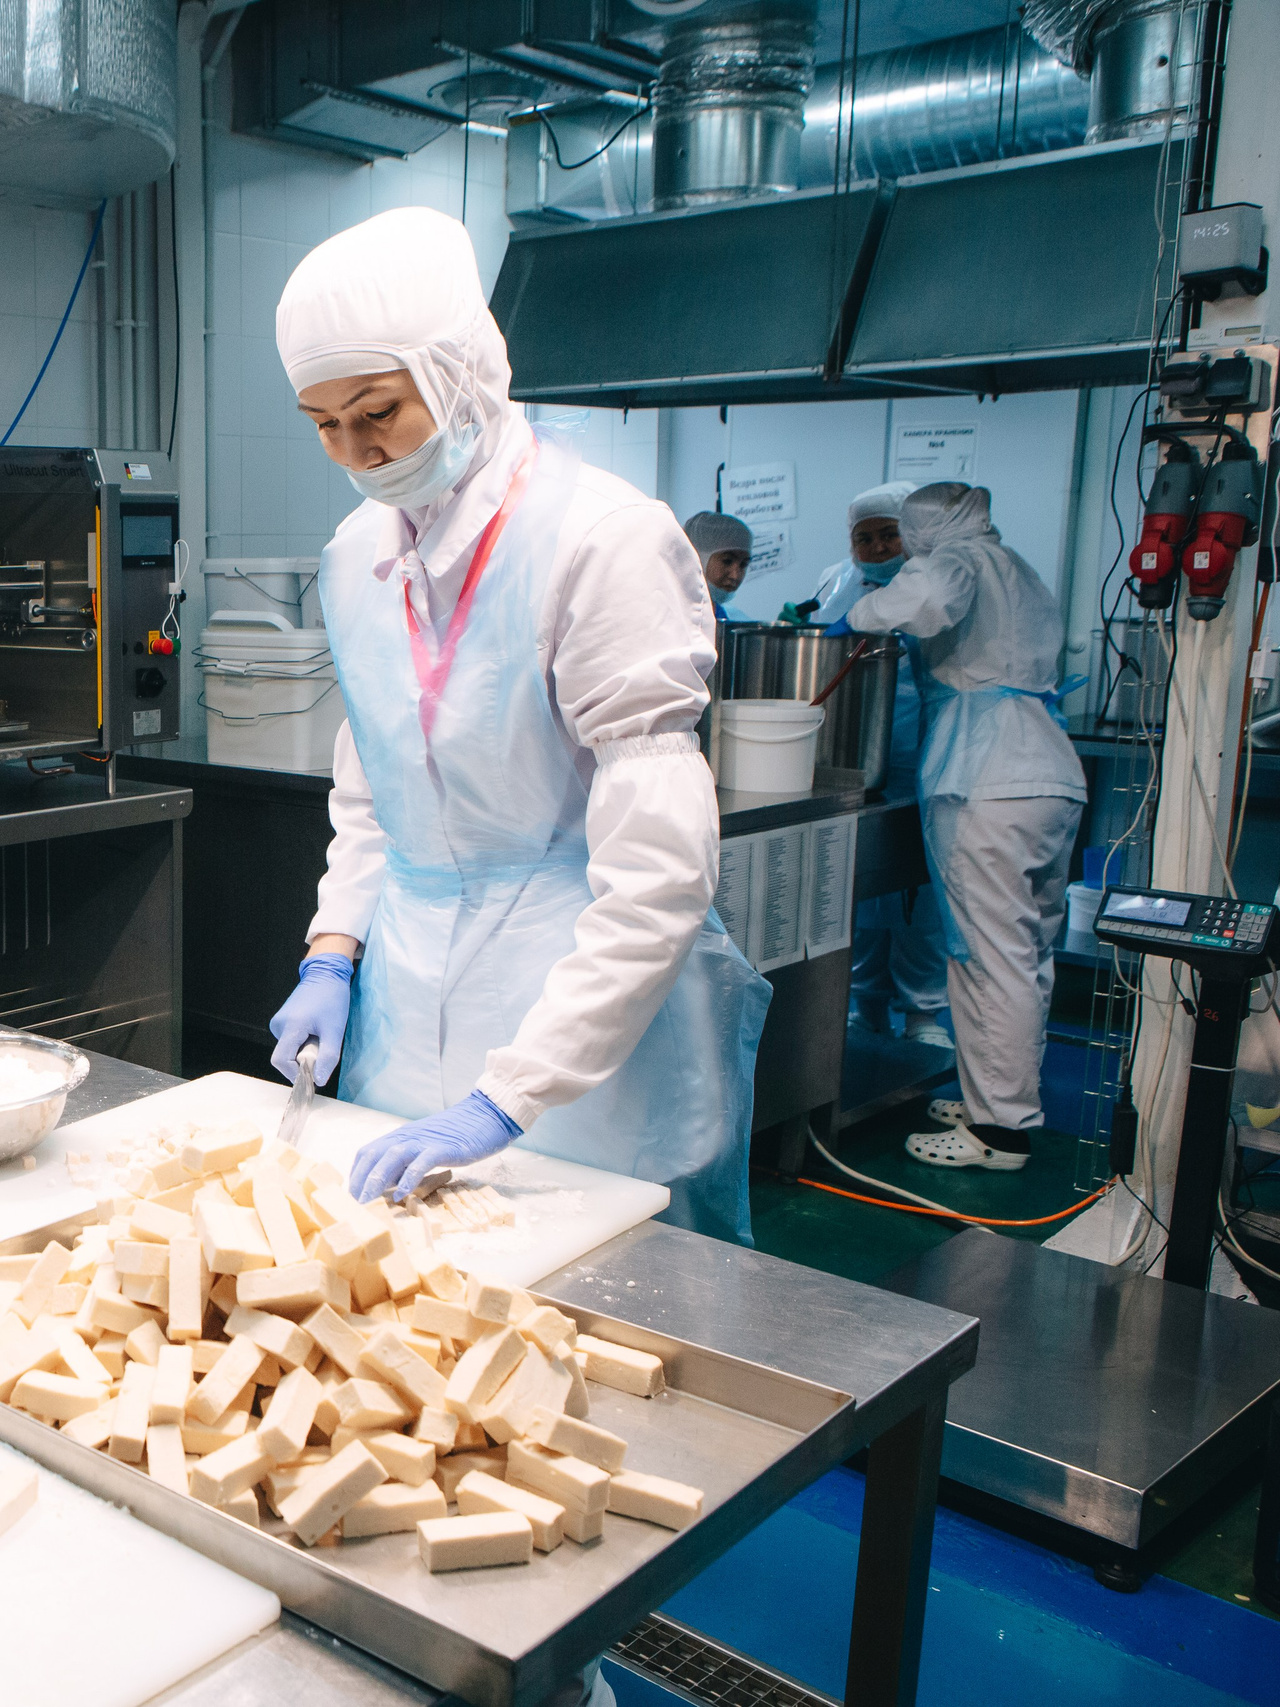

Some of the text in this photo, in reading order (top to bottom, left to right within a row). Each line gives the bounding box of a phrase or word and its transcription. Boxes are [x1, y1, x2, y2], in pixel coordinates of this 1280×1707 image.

[1194, 222, 1229, 239] 14:25
[4, 463, 84, 478] Ultracut Smart
[759, 474, 786, 484] после
[734, 503, 783, 517] обработки
[1203, 1008, 1219, 1022] 26
